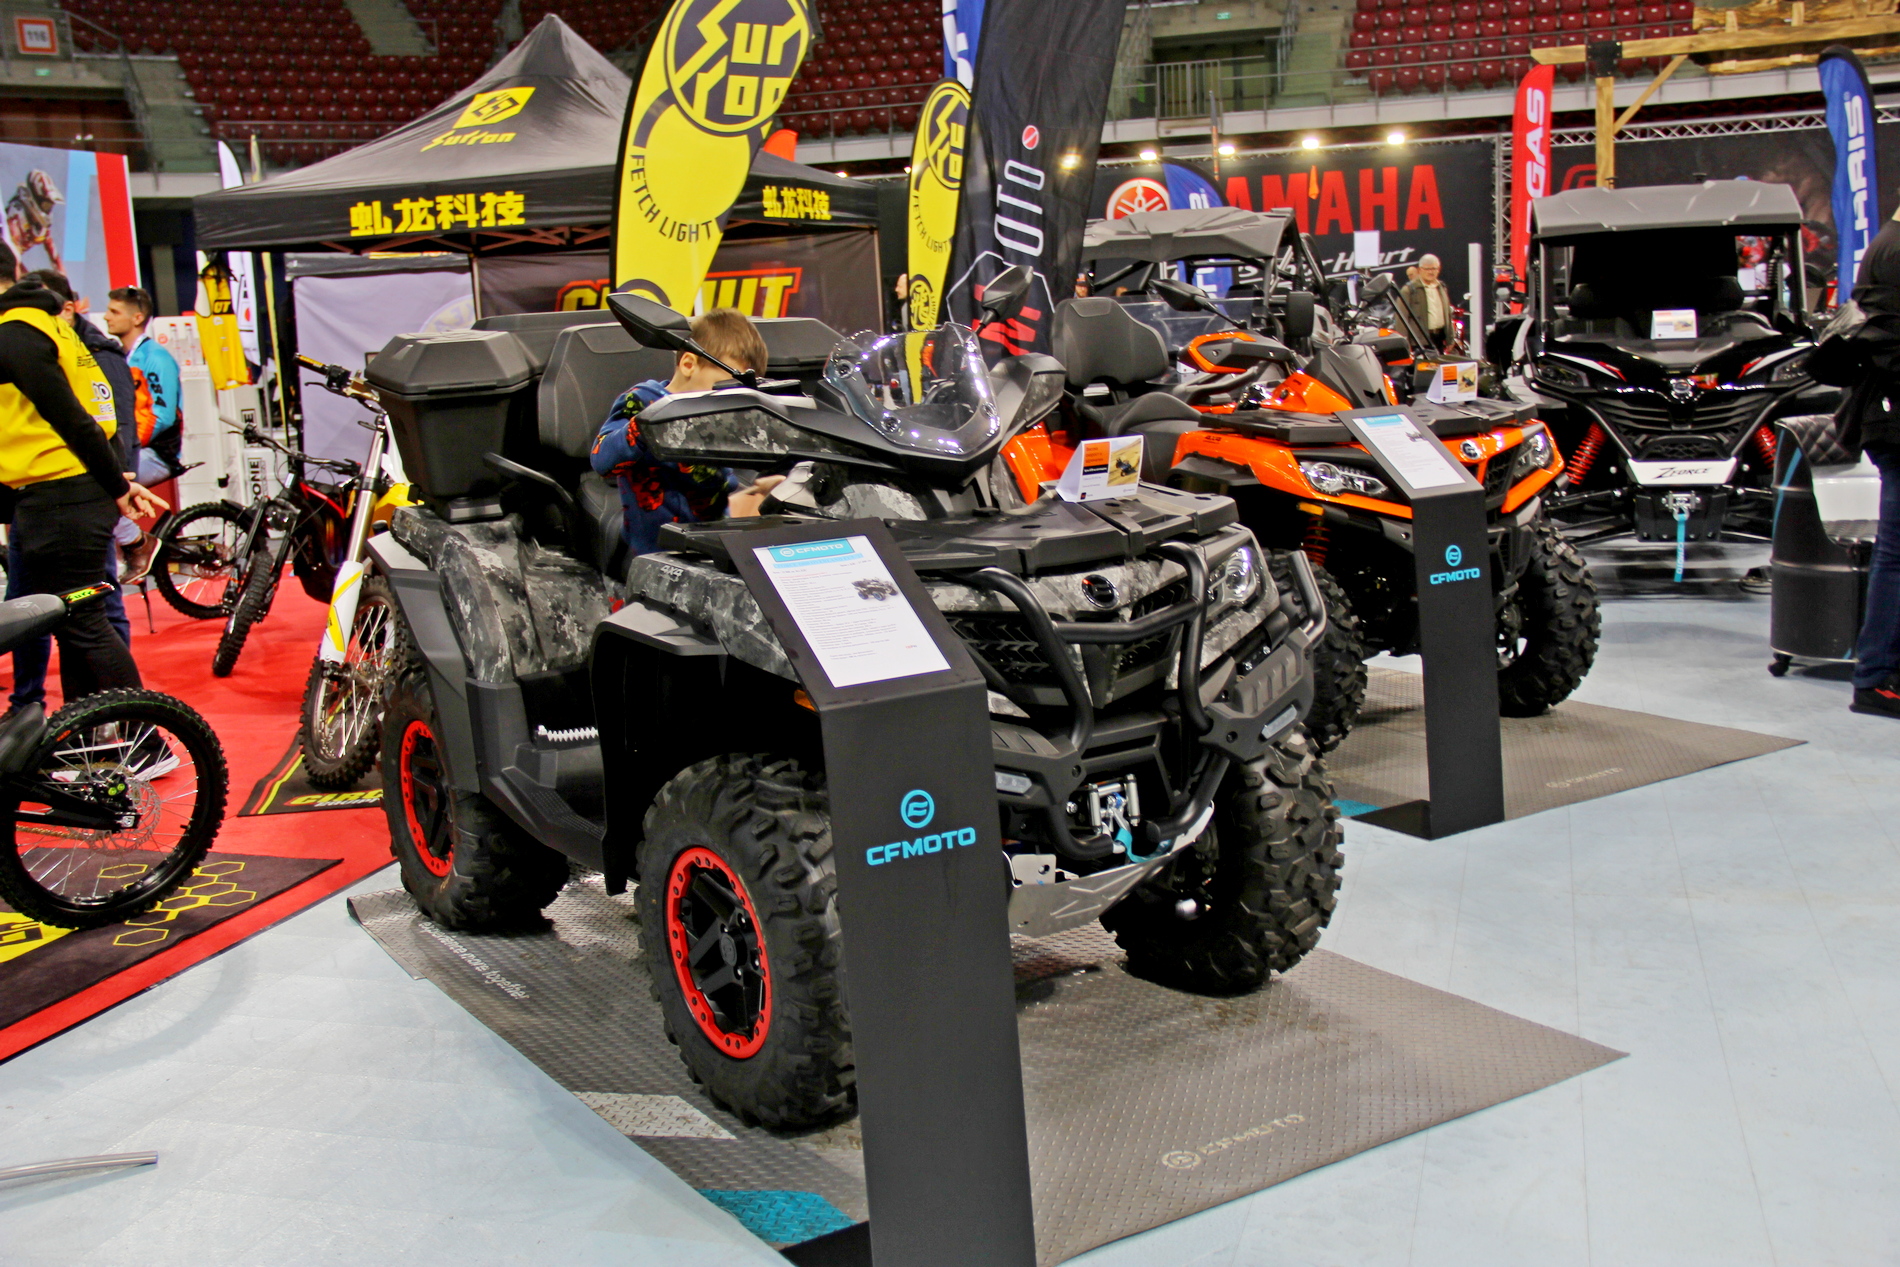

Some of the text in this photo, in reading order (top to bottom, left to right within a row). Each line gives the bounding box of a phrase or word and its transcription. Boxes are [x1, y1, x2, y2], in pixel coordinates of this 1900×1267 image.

[629, 154, 713, 243] FETCH LIGHT
[1225, 164, 1445, 236] AMAHA
[795, 543, 844, 554] CFMOTO
[1429, 567, 1481, 585] CFMOTO
[866, 827, 977, 866] CFMOTO
